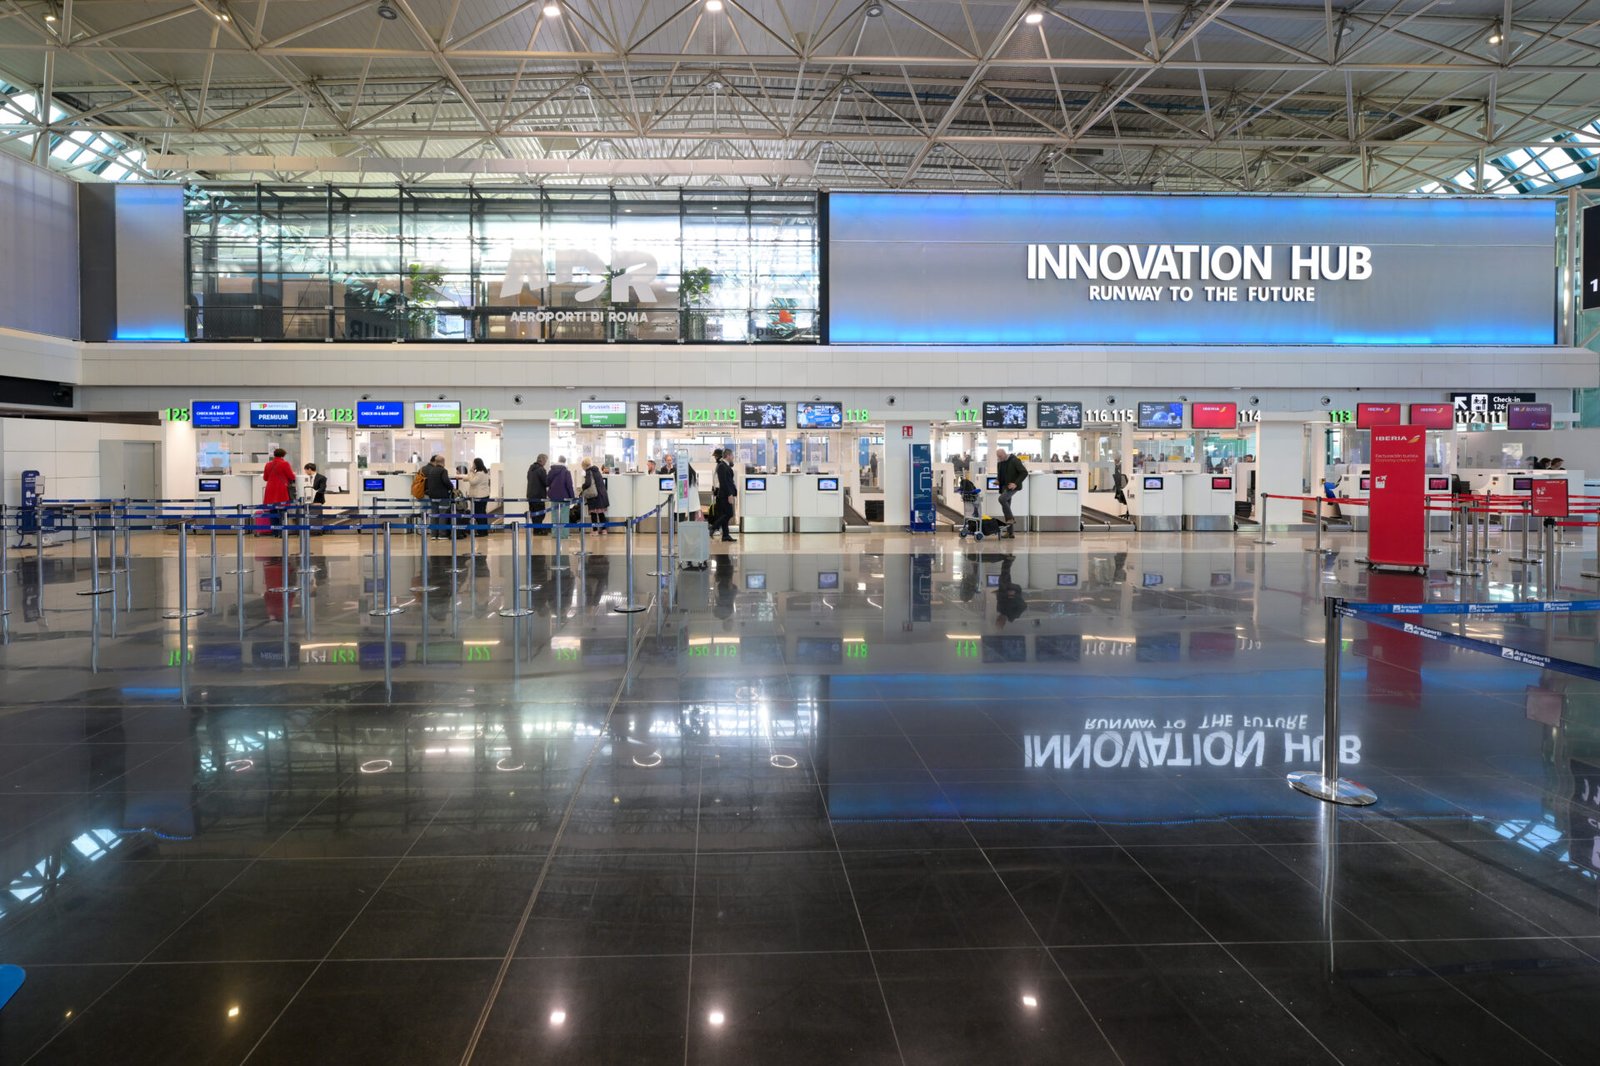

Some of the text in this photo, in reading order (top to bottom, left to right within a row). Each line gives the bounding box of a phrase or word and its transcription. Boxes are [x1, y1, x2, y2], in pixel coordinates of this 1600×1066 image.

[1027, 244, 1373, 281] INNOVATION HUB
[499, 249, 658, 303] ADR
[1089, 286, 1316, 302] RUNWAY TO THE FUTURE
[510, 311, 649, 323] AEROPORTI DI ROMA
[165, 408, 190, 421] 125
[302, 408, 326, 422] 124
[330, 408, 354, 421] 123
[466, 408, 490, 421] 122
[554, 408, 576, 420] 121
[687, 409, 710, 421] 120
[714, 409, 737, 421] 119
[846, 409, 870, 422] 118
[955, 409, 978, 422] 117
[1085, 409, 1108, 422] 116
[1111, 409, 1134, 422] 115
[1238, 409, 1261, 422] 114
[1329, 410, 1353, 423] 113
[1456, 410, 1503, 423] 112 111
[1414, 625, 1442, 636] Aeroporti
[1420, 631, 1437, 640] Roma
[1514, 650, 1551, 663] Aeroporti
[1523, 657, 1546, 667] Roma
